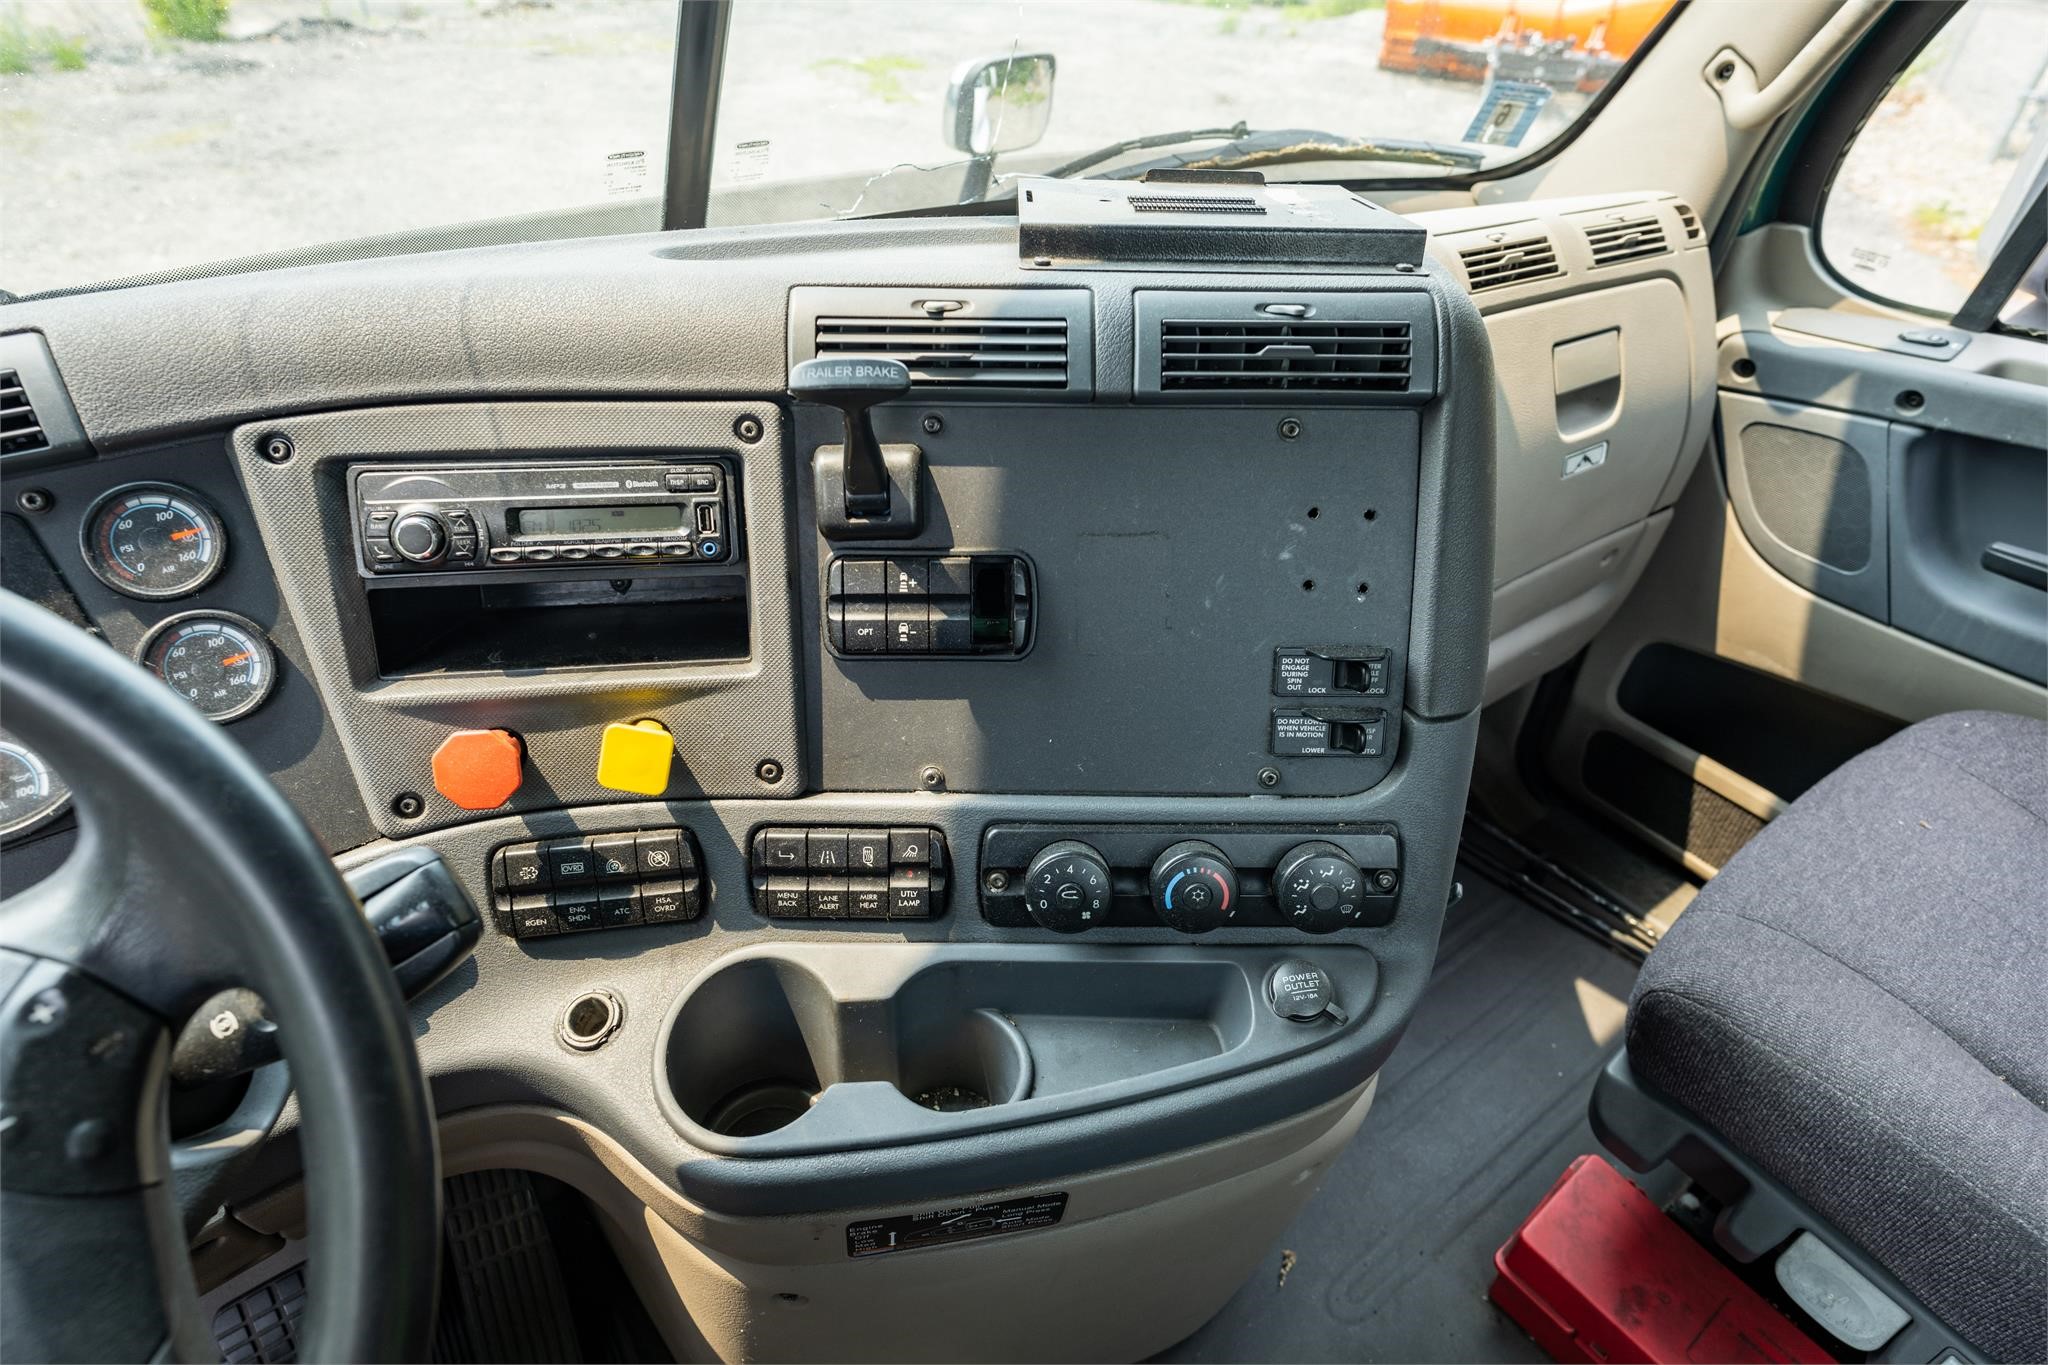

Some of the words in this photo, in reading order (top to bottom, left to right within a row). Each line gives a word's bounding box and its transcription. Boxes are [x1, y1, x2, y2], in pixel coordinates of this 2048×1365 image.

[801, 365, 852, 378] TRAILER
[855, 365, 899, 378] BRAKE
[632, 480, 659, 488] Bluetooth
[156, 511, 174, 522] 100
[118, 519, 133, 530] 60
[119, 544, 135, 554] PSI
[178, 550, 196, 562] 160
[137, 562, 145, 573] 0
[162, 565, 177, 575] AIR
[857, 628, 874, 636] OPT
[207, 636, 225, 648] 100
[171, 647, 186, 658] 60
[172, 671, 188, 681] PSI
[229, 674, 247, 686] 160
[189, 688, 198, 698] 0
[213, 689, 228, 699] AIR
[15, 785, 35, 799] 100
[562, 863, 584, 873] OVRD
[1066, 864, 1074, 874] 4
[1043, 874, 1051, 884] 2
[1089, 875, 1097, 885] 6
[900, 890, 918, 898] UTLY
[898, 899, 921, 907] LAMP
[1040, 899, 1048, 909] 0
[1092, 899, 1100, 909] 8
[569, 906, 586, 914] ENG
[614, 907, 630, 916] ATC
[654, 904, 676, 913] OVRD
[525, 918, 547, 928] RGEN
[568, 914, 591, 922] SHDN
[1282, 972, 1319, 984] POWER
[1284, 980, 1320, 992] OUTLET
[937, 1208, 966, 1218] Down
[975, 1204, 1000, 1212] Push
[1002, 1205, 1035, 1214] Manual
[1037, 1201, 1062, 1209] Mode
[1001, 1211, 1024, 1219] Long
[1026, 1207, 1051, 1215] Press
[849, 1224, 884, 1233] Engine
[849, 1229, 878, 1238] Brake
